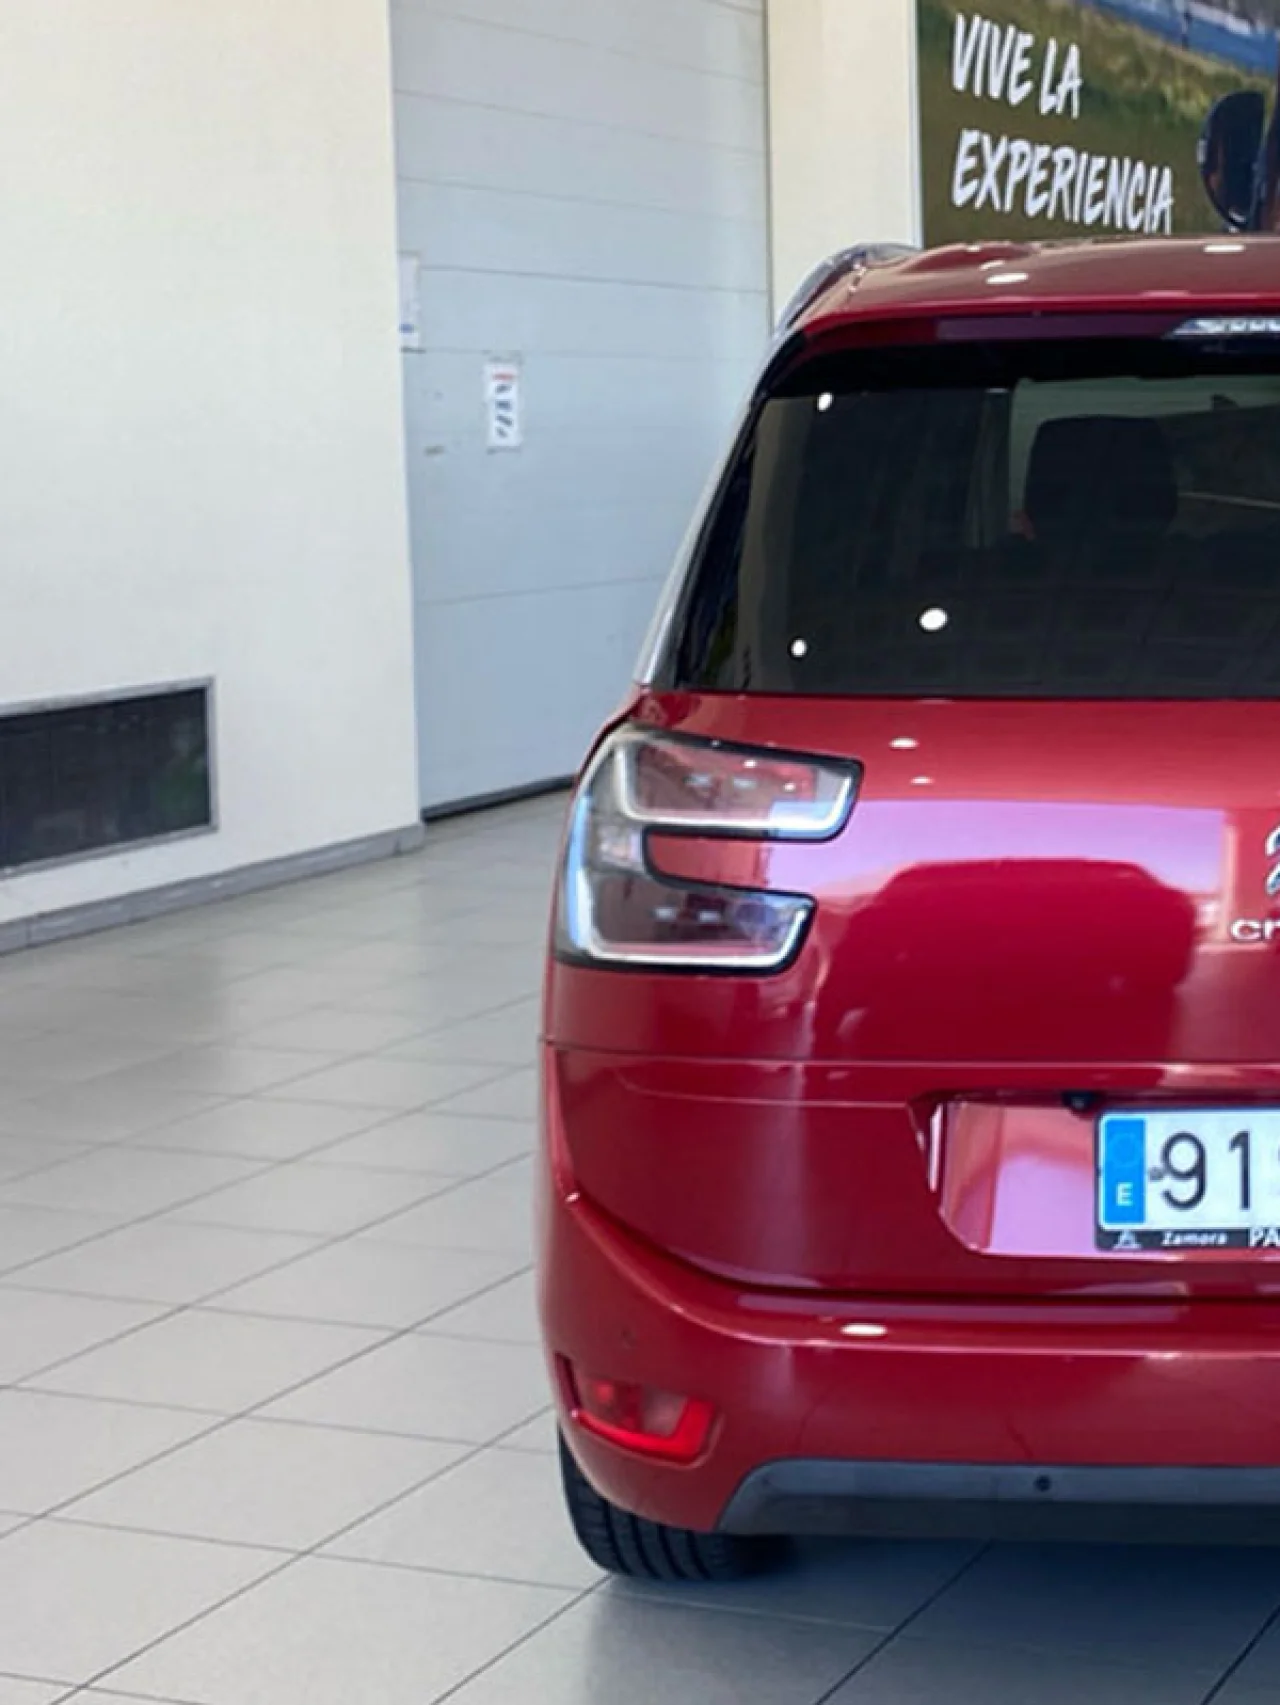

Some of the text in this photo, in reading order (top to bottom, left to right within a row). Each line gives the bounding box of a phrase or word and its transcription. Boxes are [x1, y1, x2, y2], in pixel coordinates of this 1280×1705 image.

[953, 13, 1083, 119] VIVE LA
[953, 128, 1174, 234] EXPERIENCIA
[1117, 1183, 1132, 1206] E
[1161, 1231, 1227, 1246] Zamora
